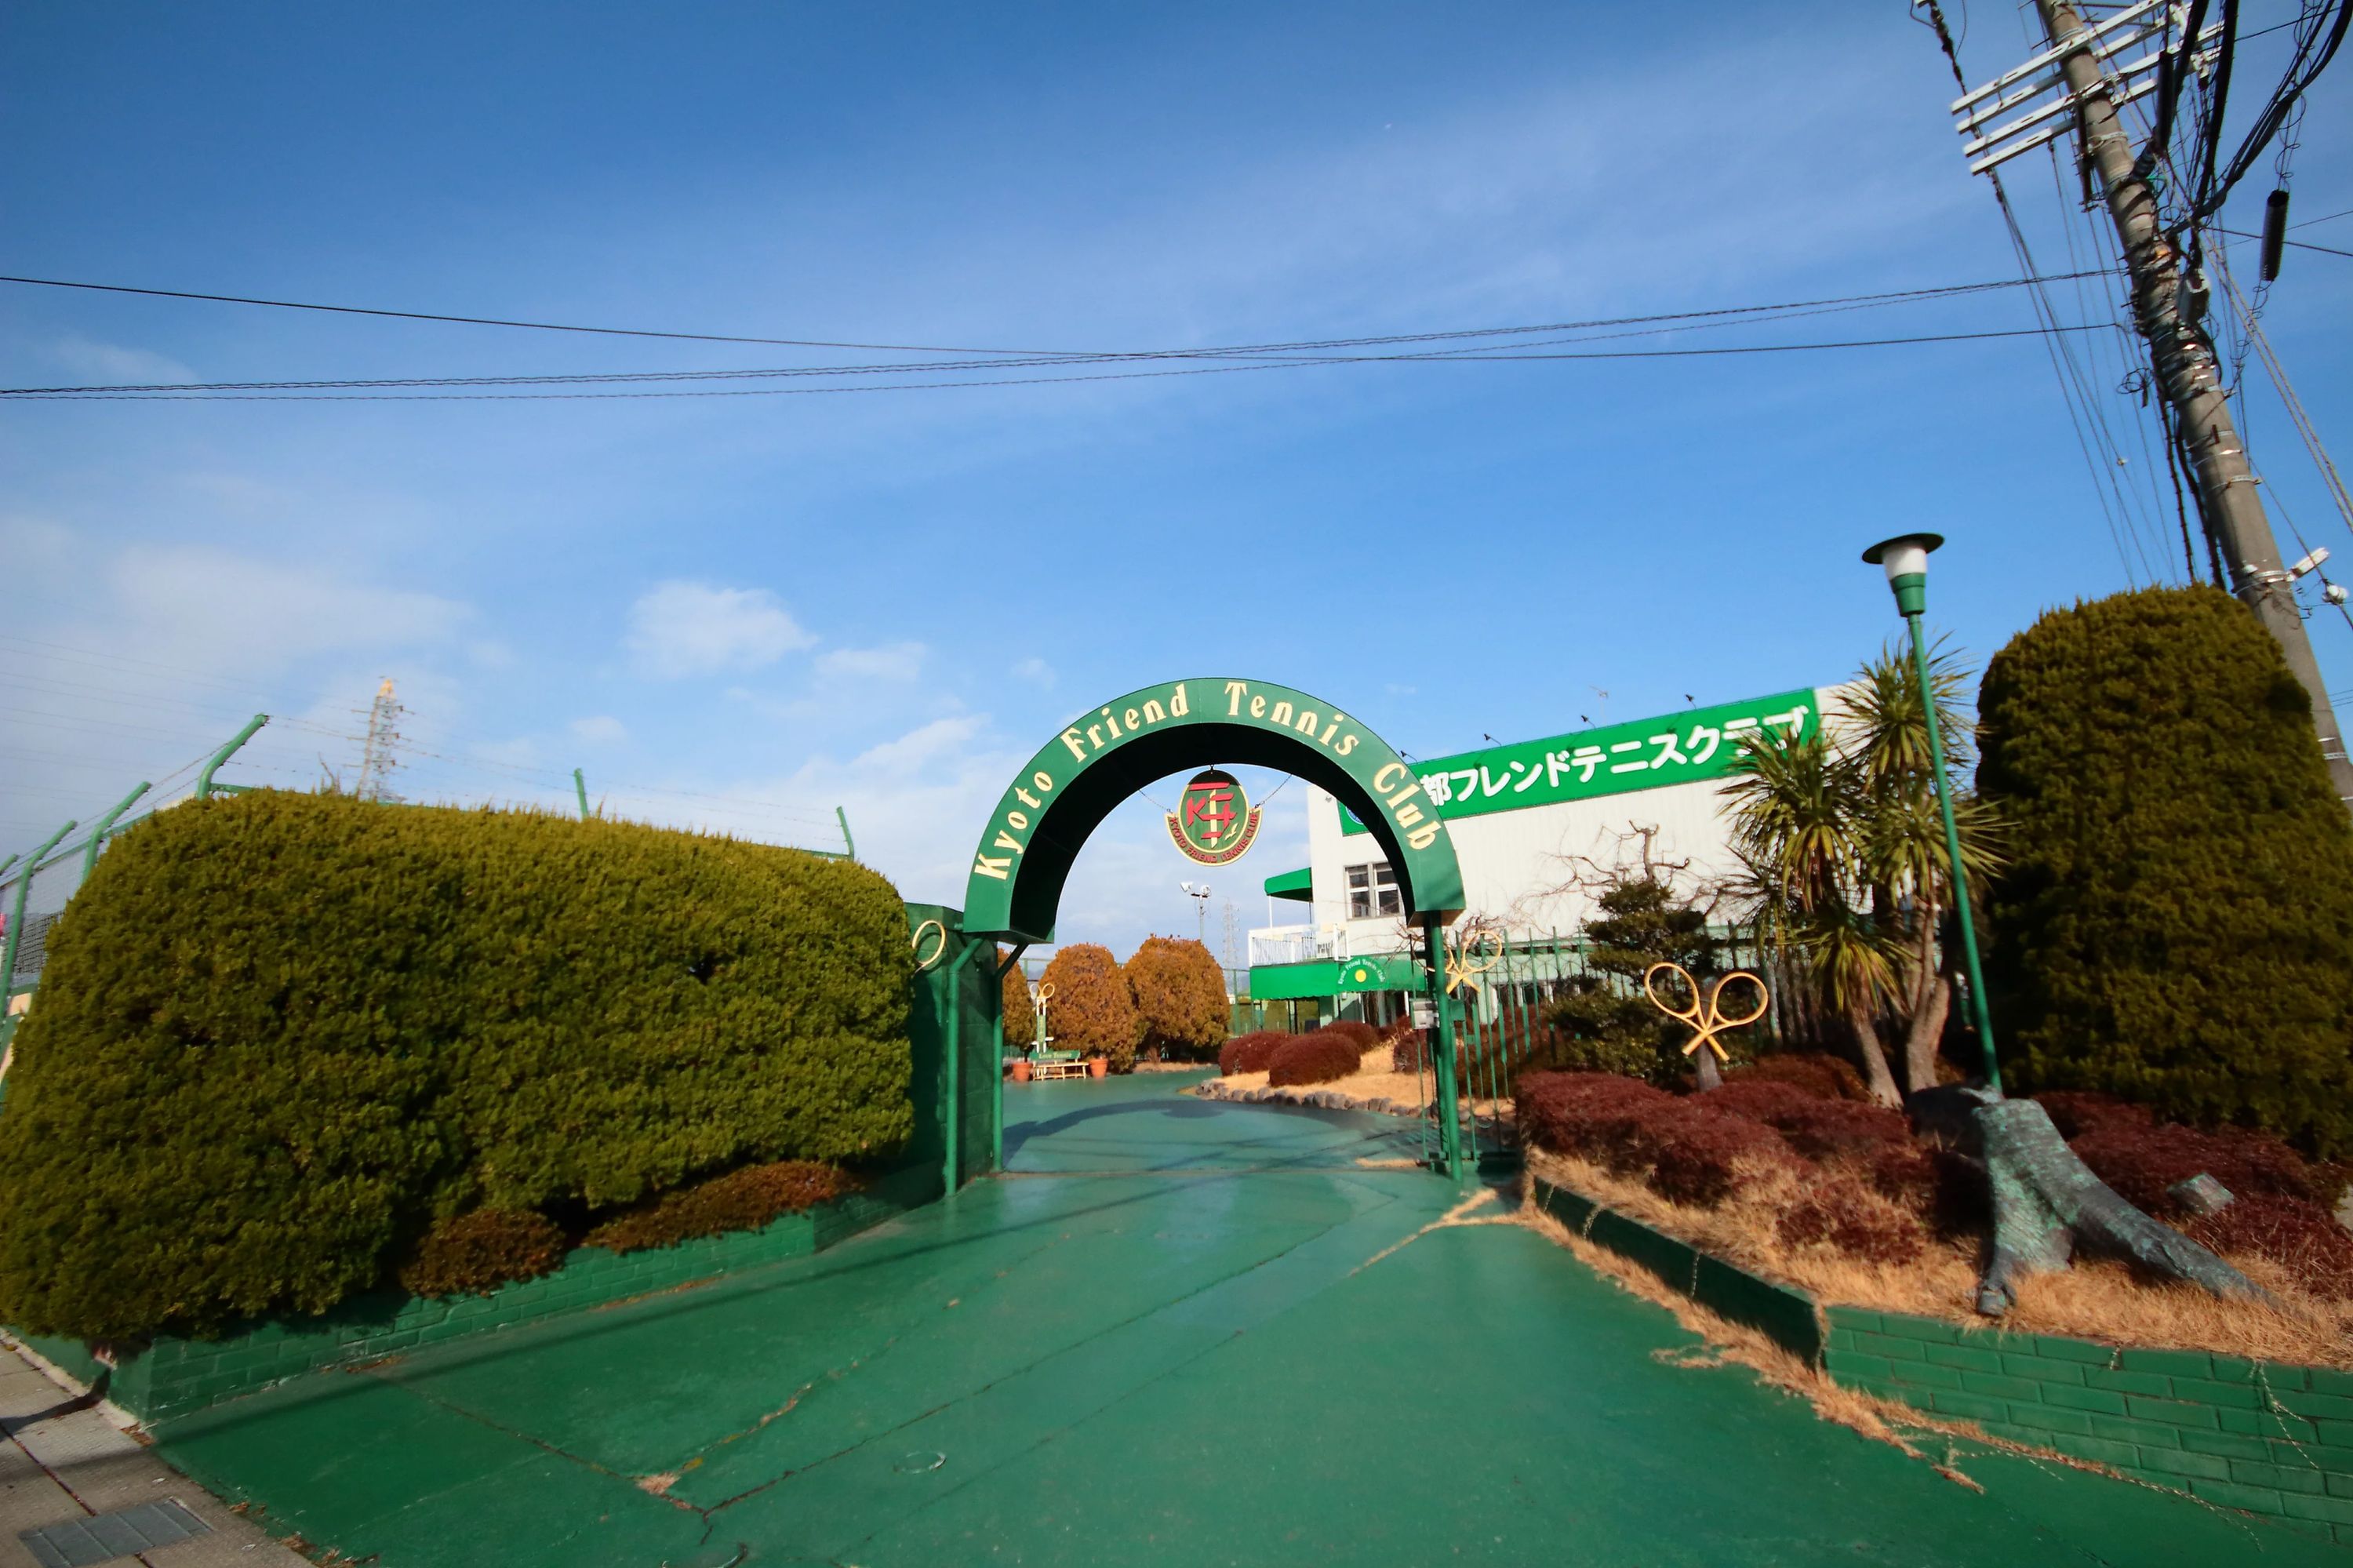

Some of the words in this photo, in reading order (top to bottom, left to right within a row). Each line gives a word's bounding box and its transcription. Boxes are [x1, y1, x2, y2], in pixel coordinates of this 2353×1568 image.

[974, 771, 1053, 880] Kyoto
[1060, 683, 1190, 763] Friend
[1224, 682, 1359, 756] Tennis
[1373, 762, 1442, 850] Club
[1169, 816, 1187, 848] KYOTO
[1185, 846, 1217, 864] FRIEND
[1220, 839, 1248, 862] TENNIS
[1246, 813, 1259, 839] CLUB
